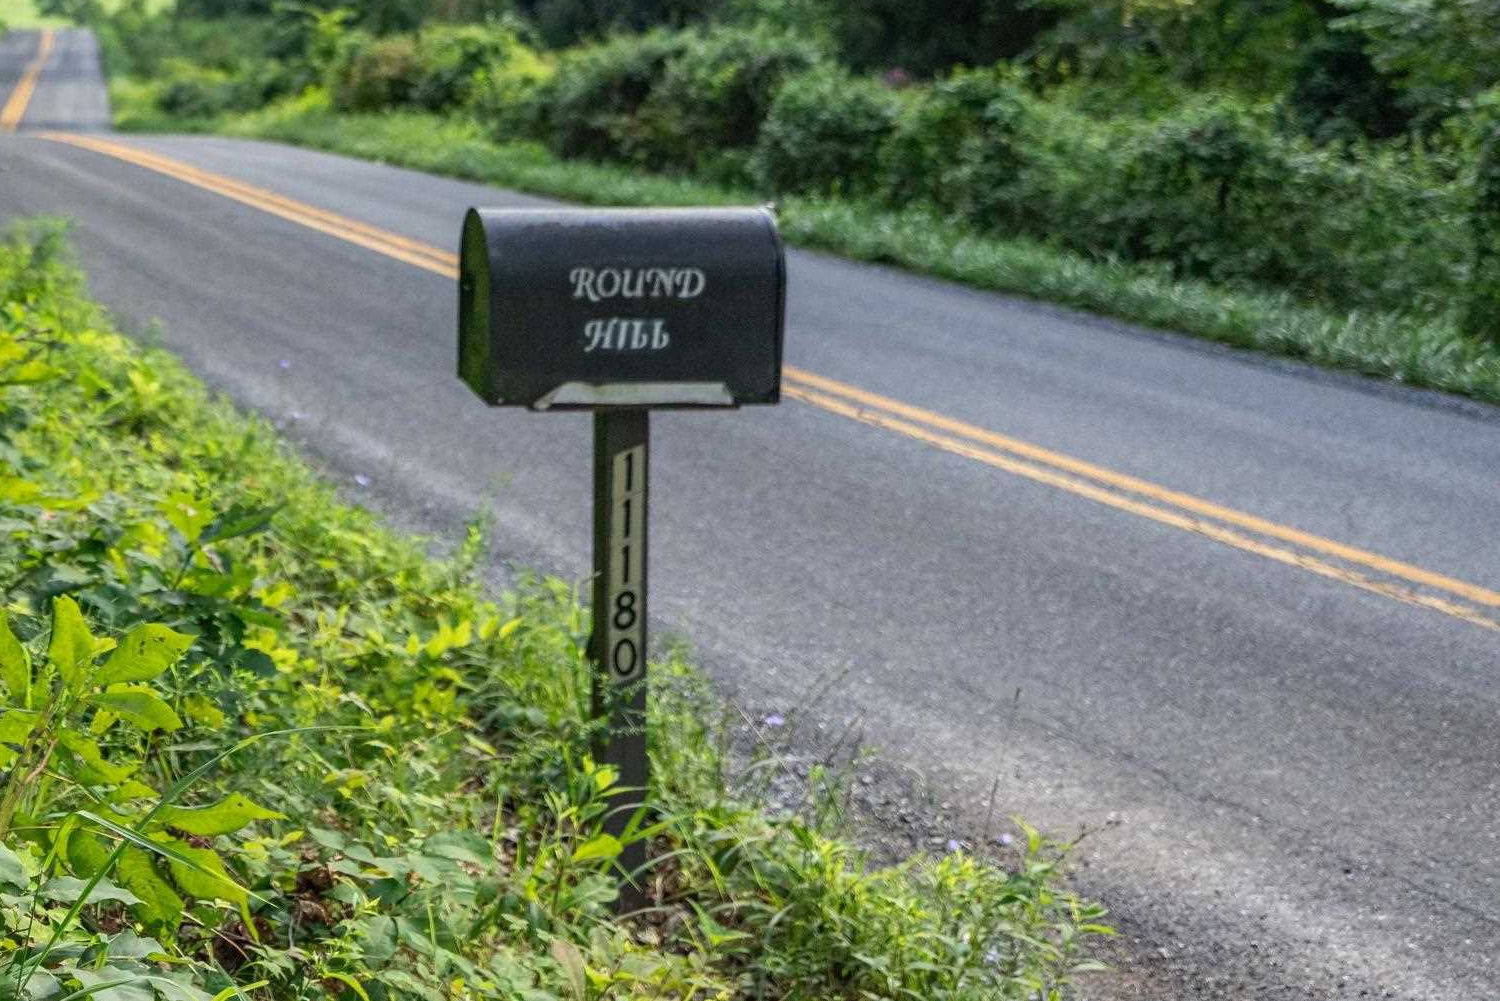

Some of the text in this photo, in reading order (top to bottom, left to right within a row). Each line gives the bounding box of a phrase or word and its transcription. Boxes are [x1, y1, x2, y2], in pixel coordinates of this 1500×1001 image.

[569, 266, 706, 301] ROUND
[583, 317, 669, 352] HILL
[613, 451, 638, 677] 11180
